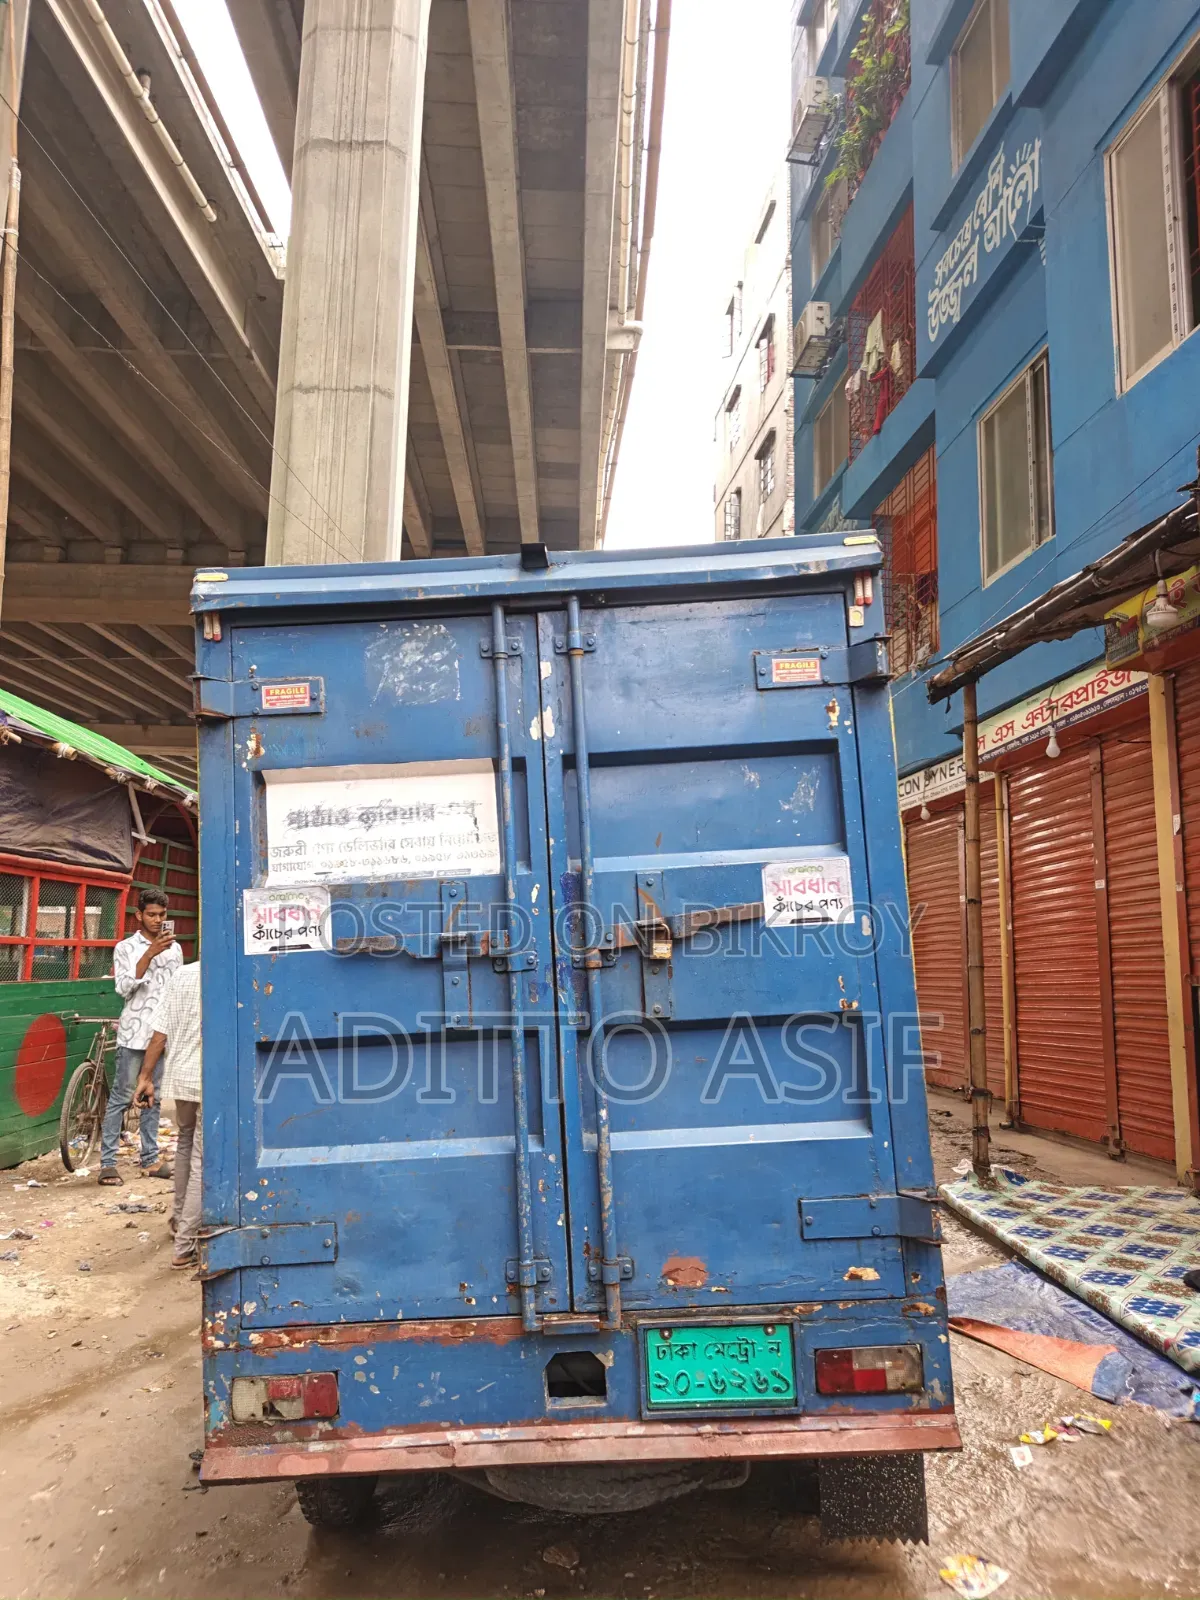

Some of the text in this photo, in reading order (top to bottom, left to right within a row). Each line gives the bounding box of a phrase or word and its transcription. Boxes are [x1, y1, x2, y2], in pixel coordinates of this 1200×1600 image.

[972, 140, 1005, 231] বেশি
[983, 137, 1042, 253] আলো
[780, 661, 816, 670] FRAGILE
[269, 687, 305, 696] FRAGILE
[788, 865, 824, 874] oraimo
[771, 877, 842, 897] সাবধান
[268, 892, 305, 902] oraimo
[773, 895, 844, 913] কাঁচের পণ্য
[252, 923, 323, 941] কাঁচের পণ্য
[655, 1340, 698, 1361] ঢাকা
[653, 1367, 791, 1397] ২০-৬২৬১
